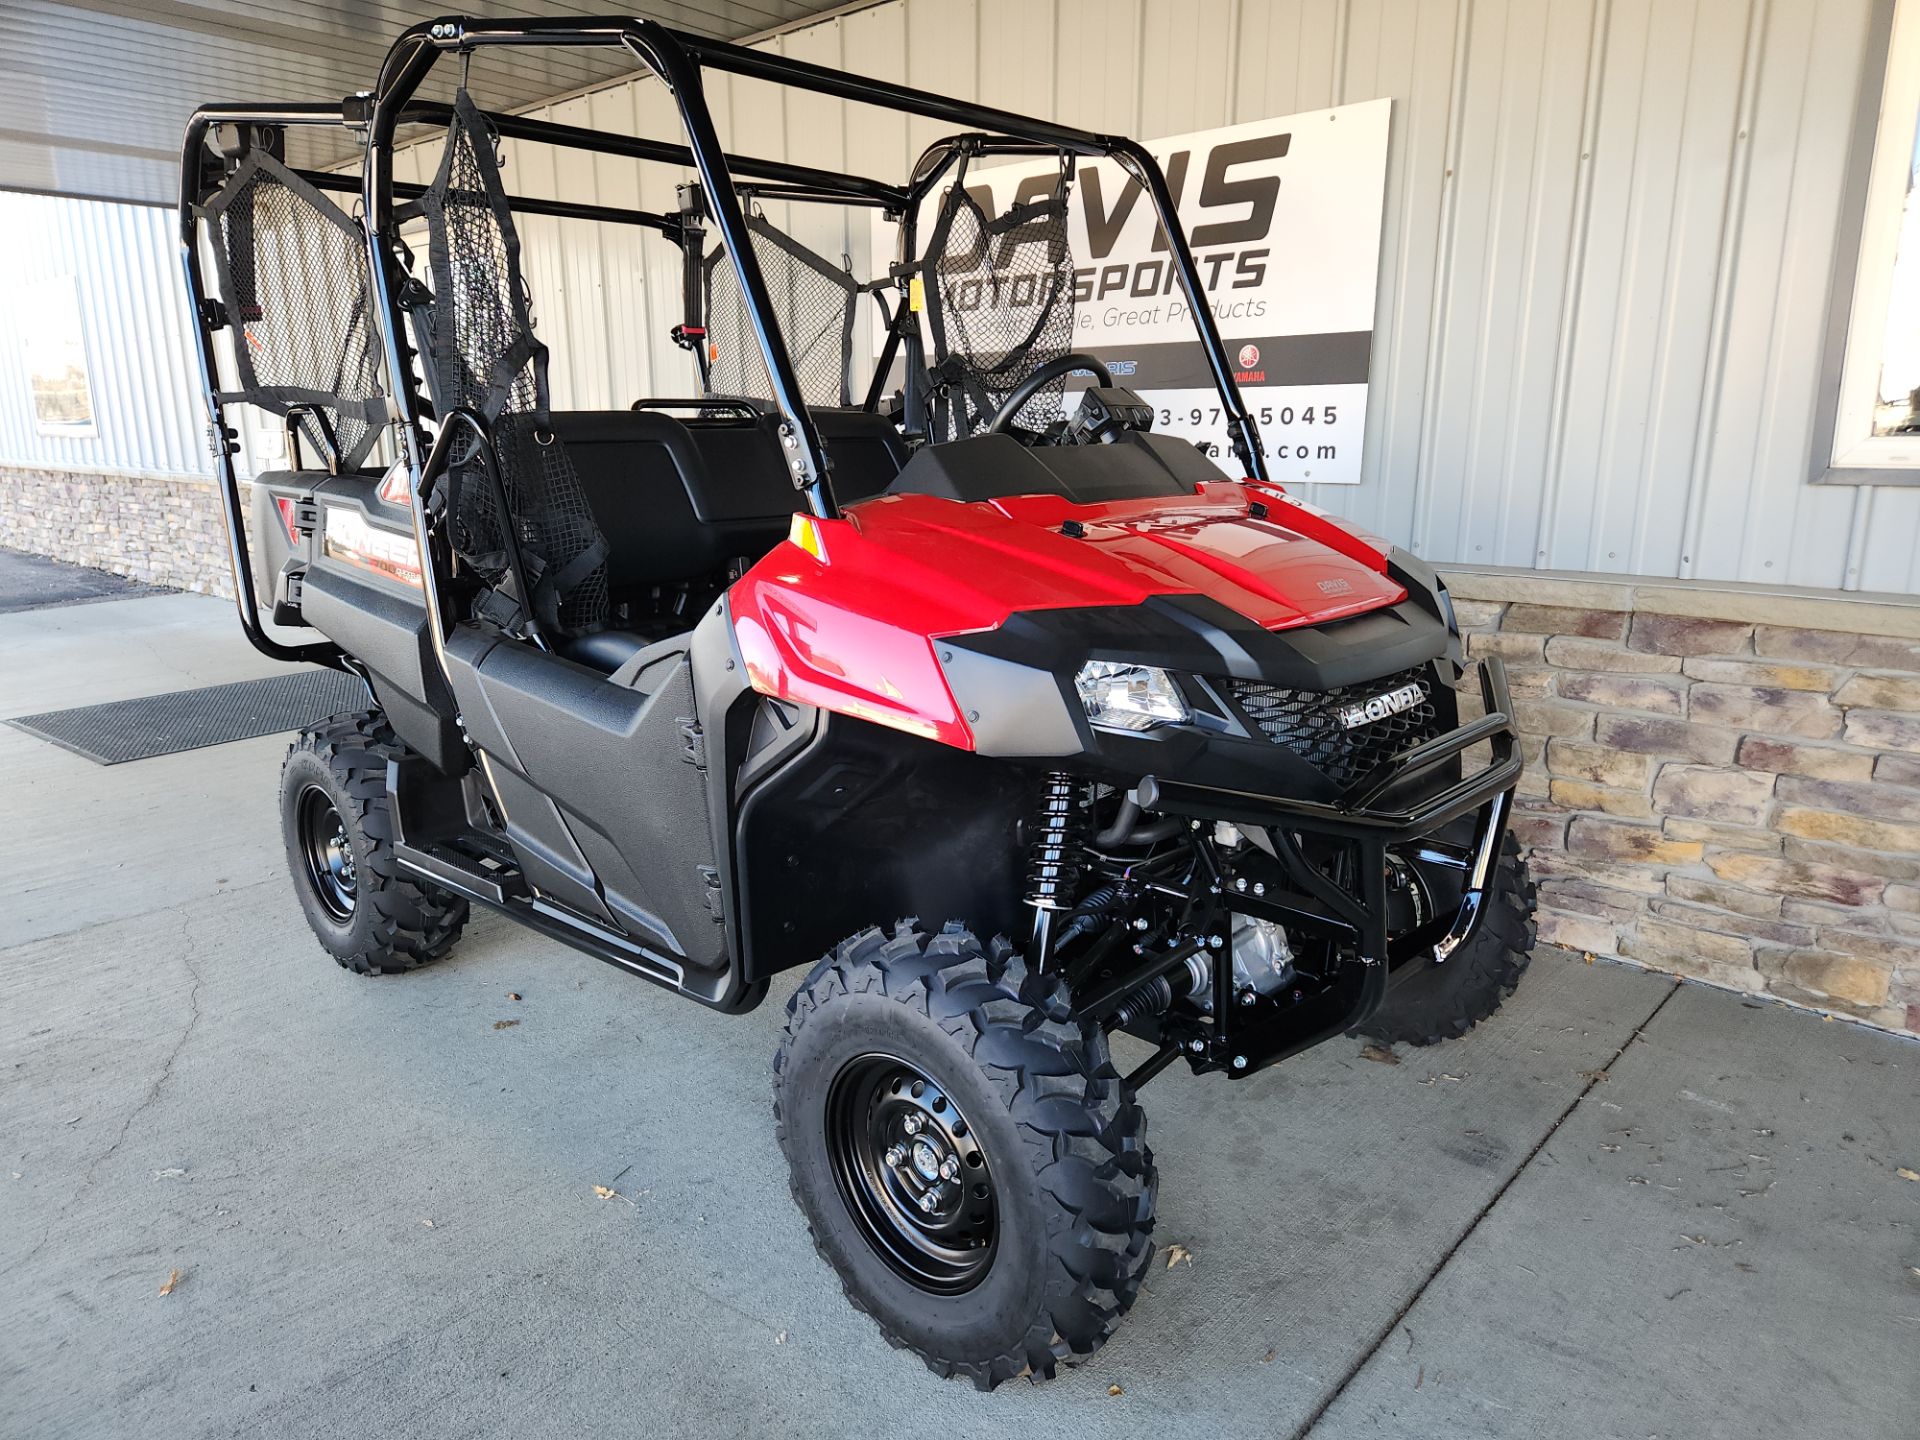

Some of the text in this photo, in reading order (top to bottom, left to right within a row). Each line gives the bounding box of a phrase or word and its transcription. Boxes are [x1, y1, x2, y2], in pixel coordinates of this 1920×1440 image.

[935, 133, 1292, 275] DAVIS
[1103, 304, 1161, 328] Great
[1166, 296, 1267, 323] Prducts
[1340, 683, 1427, 729] HONDA
